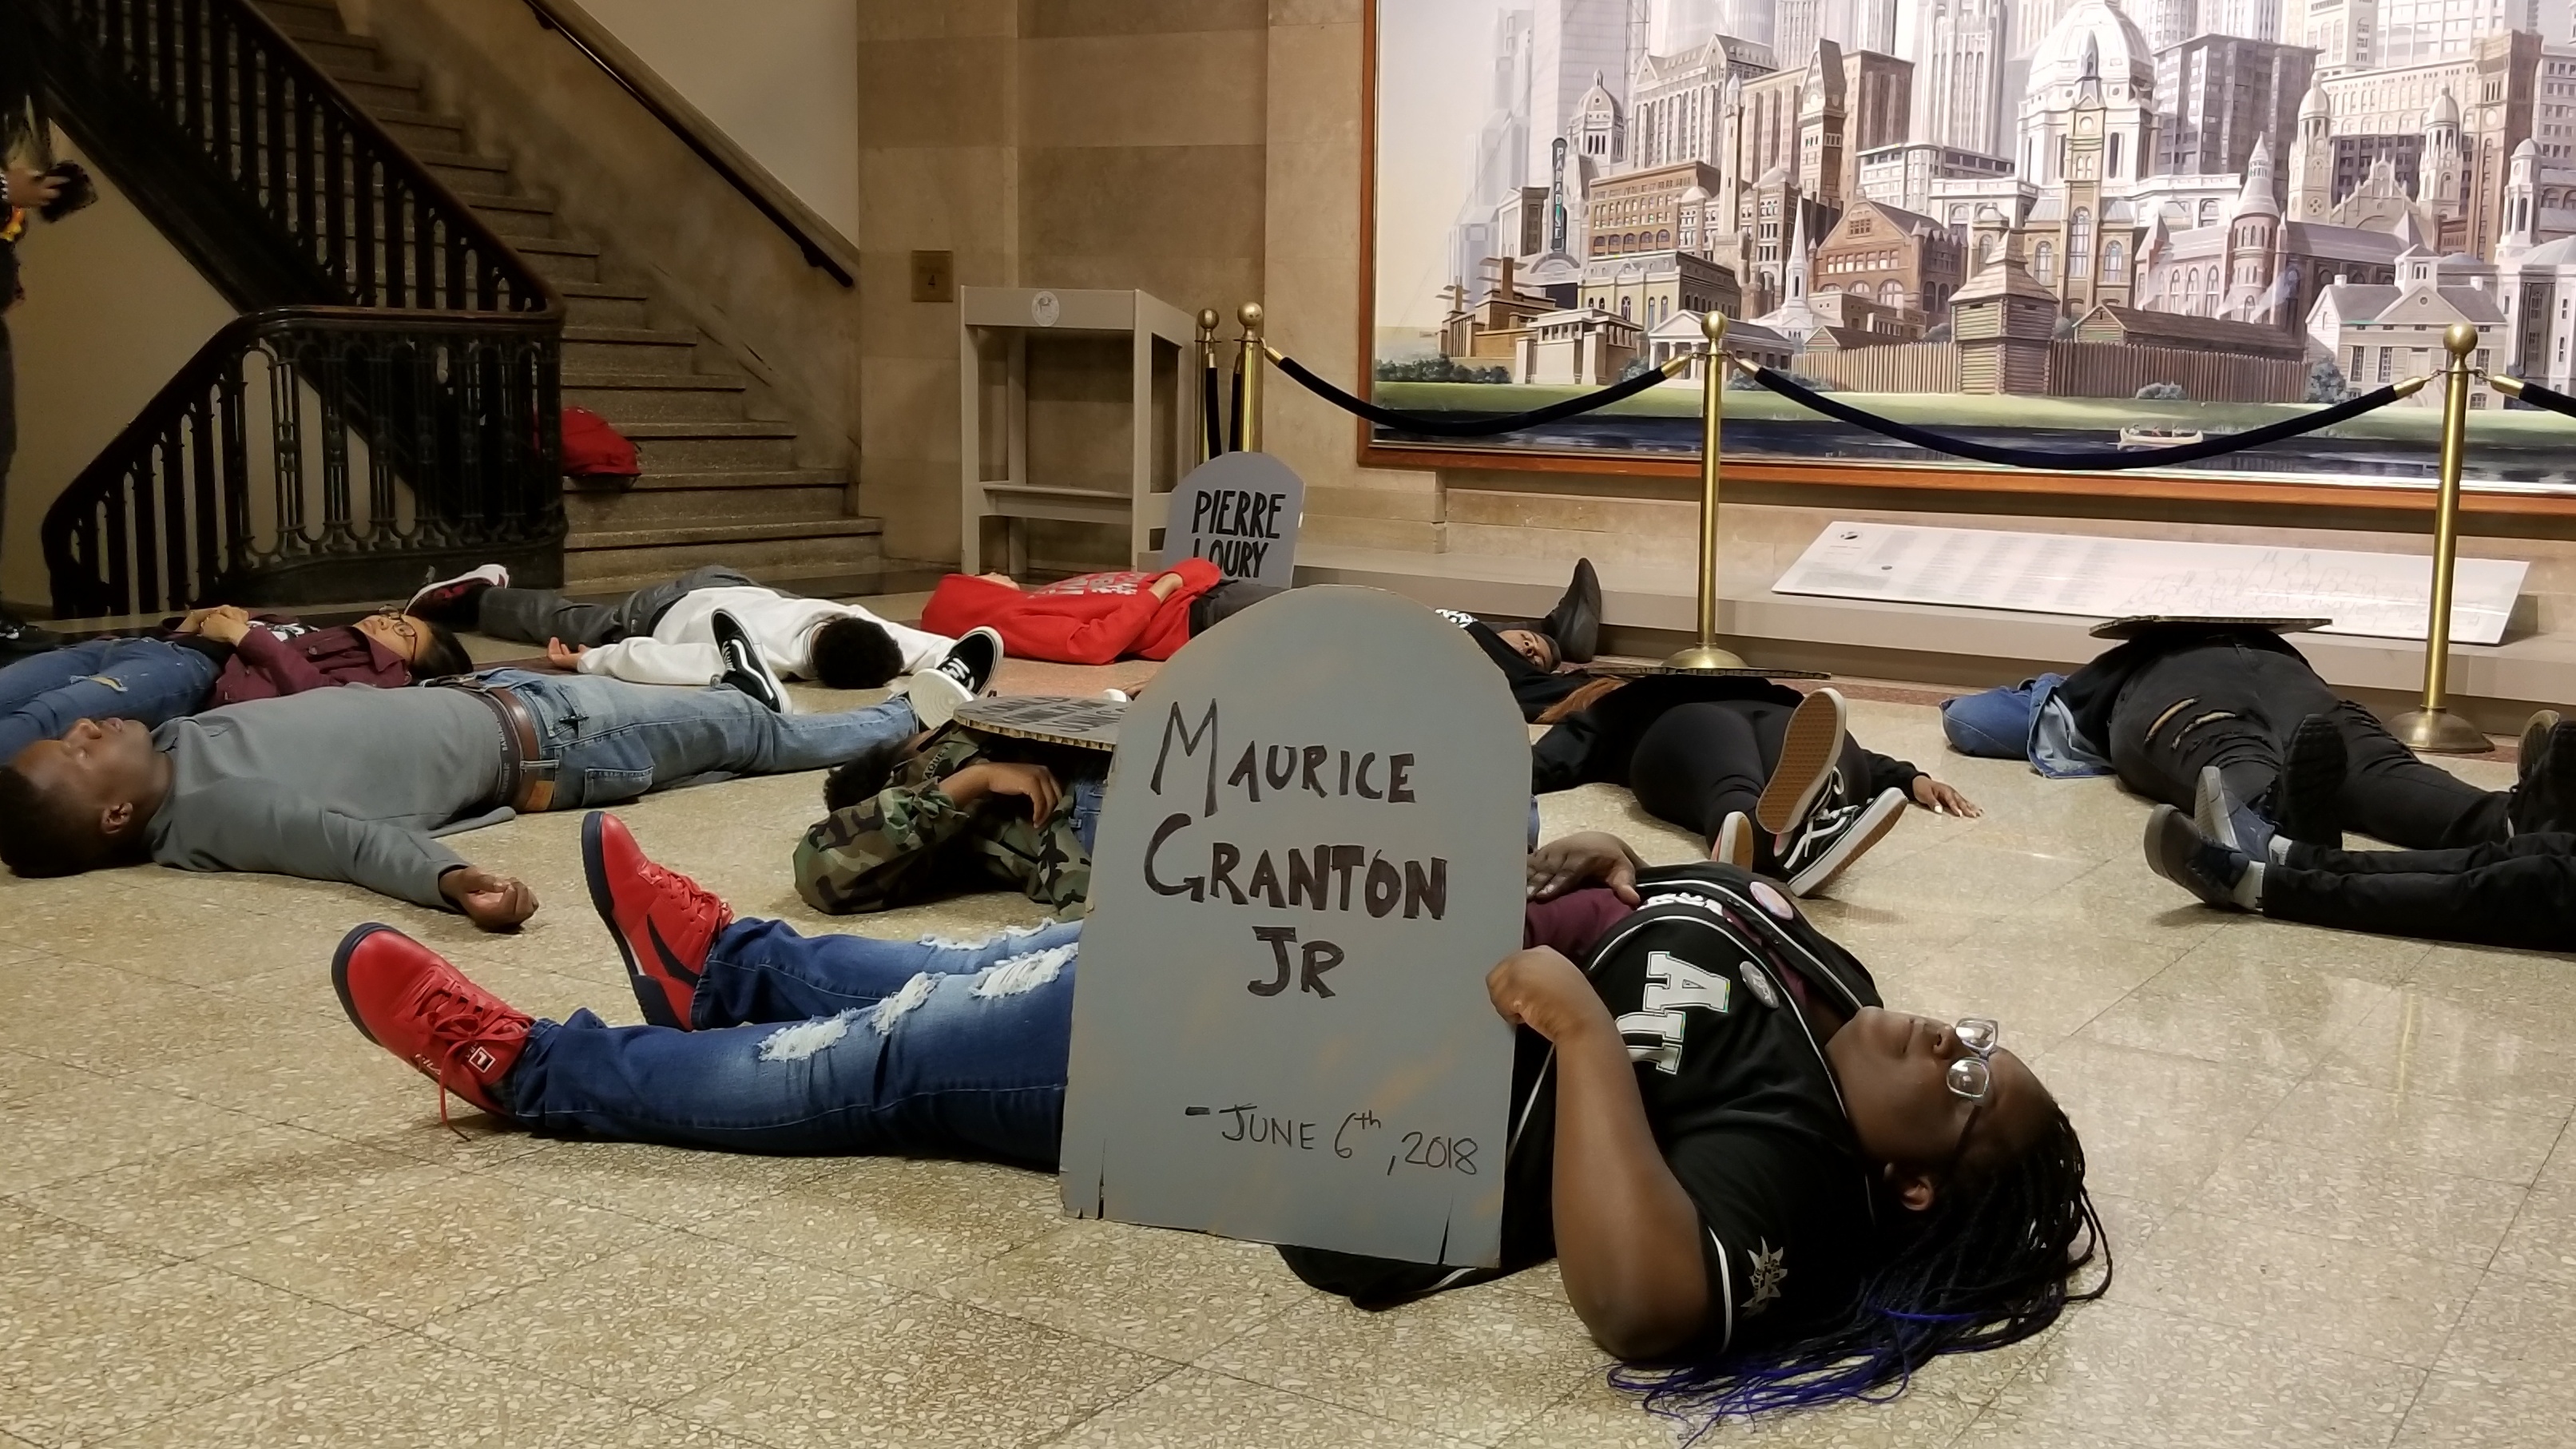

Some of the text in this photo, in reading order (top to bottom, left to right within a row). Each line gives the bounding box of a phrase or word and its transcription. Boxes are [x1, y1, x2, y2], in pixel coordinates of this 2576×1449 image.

[1192, 490, 1286, 538] PIERRE
[1150, 697, 1416, 818] MAURICE
[1144, 812, 1447, 920] GRANTON
[1247, 926, 1345, 998] JR
